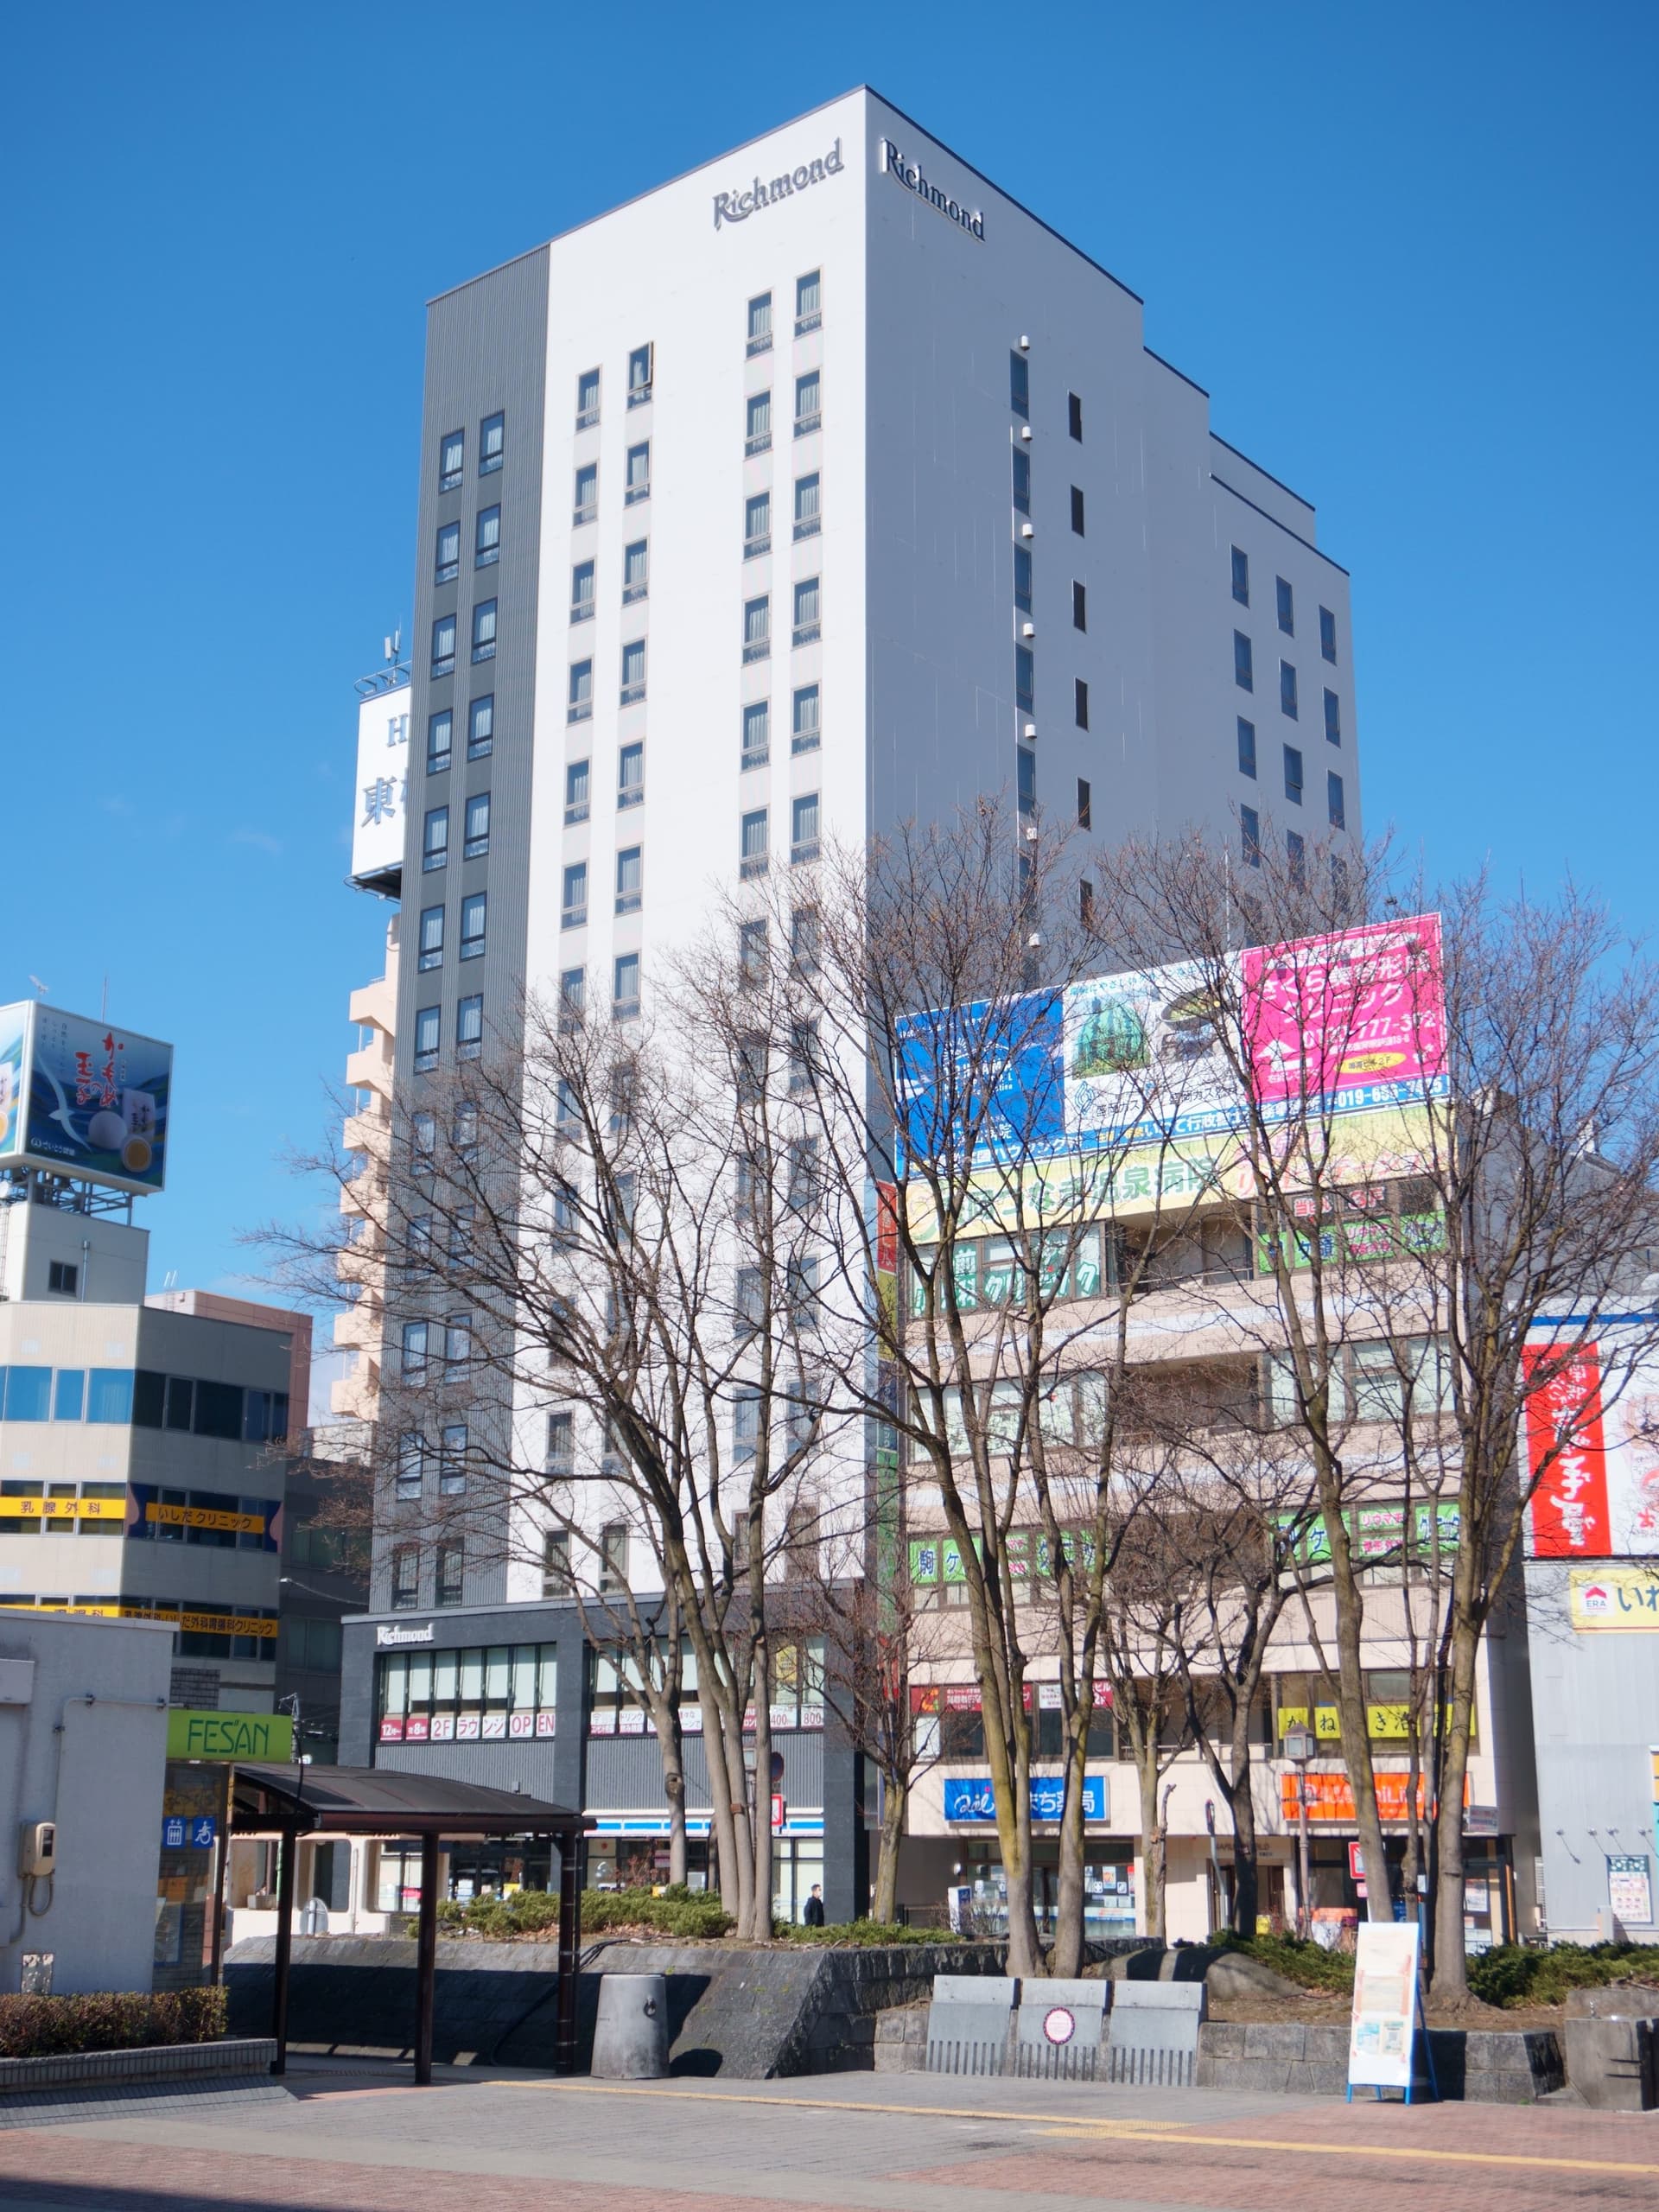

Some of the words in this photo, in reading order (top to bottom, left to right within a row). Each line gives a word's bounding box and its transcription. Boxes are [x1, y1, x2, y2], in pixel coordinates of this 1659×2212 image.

[713, 137, 844, 231] Richmond
[880, 137, 985, 242] Richmond
[21, 1501, 100, 1514] 乳腺外科
[158, 1510, 251, 1529] いしだクリニック
[1586, 1599, 1607, 1608] ERA
[377, 1624, 434, 1645] Richmond
